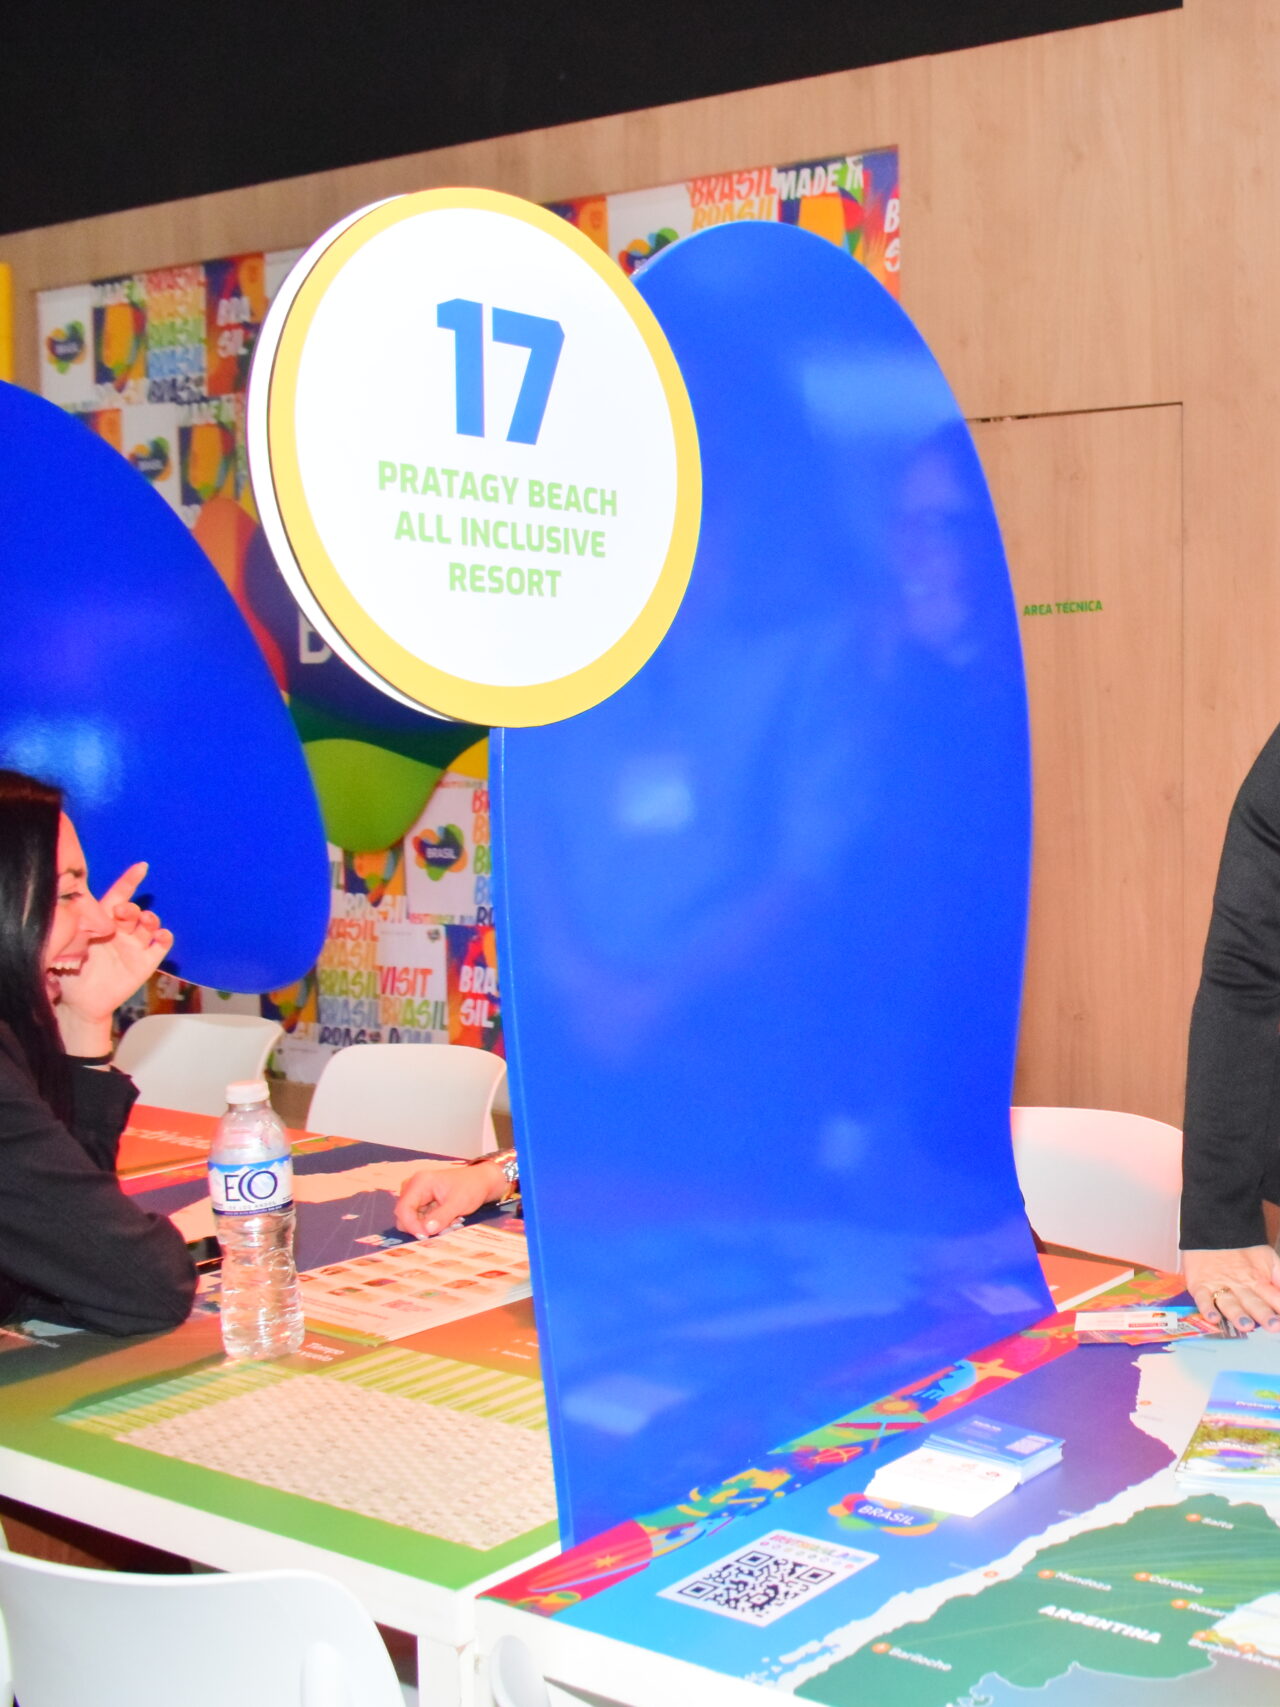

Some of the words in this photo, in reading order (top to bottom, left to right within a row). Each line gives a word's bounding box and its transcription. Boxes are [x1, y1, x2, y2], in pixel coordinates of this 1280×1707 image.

[691, 166, 776, 208] BRASIL
[777, 163, 843, 200] MADE
[437, 298, 565, 446] 17
[378, 460, 519, 505] PRATAGY
[528, 480, 618, 517] BEACH
[394, 511, 452, 544] ALL
[460, 517, 606, 558] INCLUSIVE
[449, 562, 562, 598] RESORT
[1023, 604, 1052, 616] AREA
[1055, 600, 1102, 614] TECNICA
[379, 966, 432, 998] VISIT
[459, 965, 497, 995] BRA
[460, 998, 494, 1029] SIL
[224, 1169, 277, 1203] ECO
[857, 1503, 915, 1526] BRASIL
[1038, 1604, 1161, 1644] ARGENTINA
